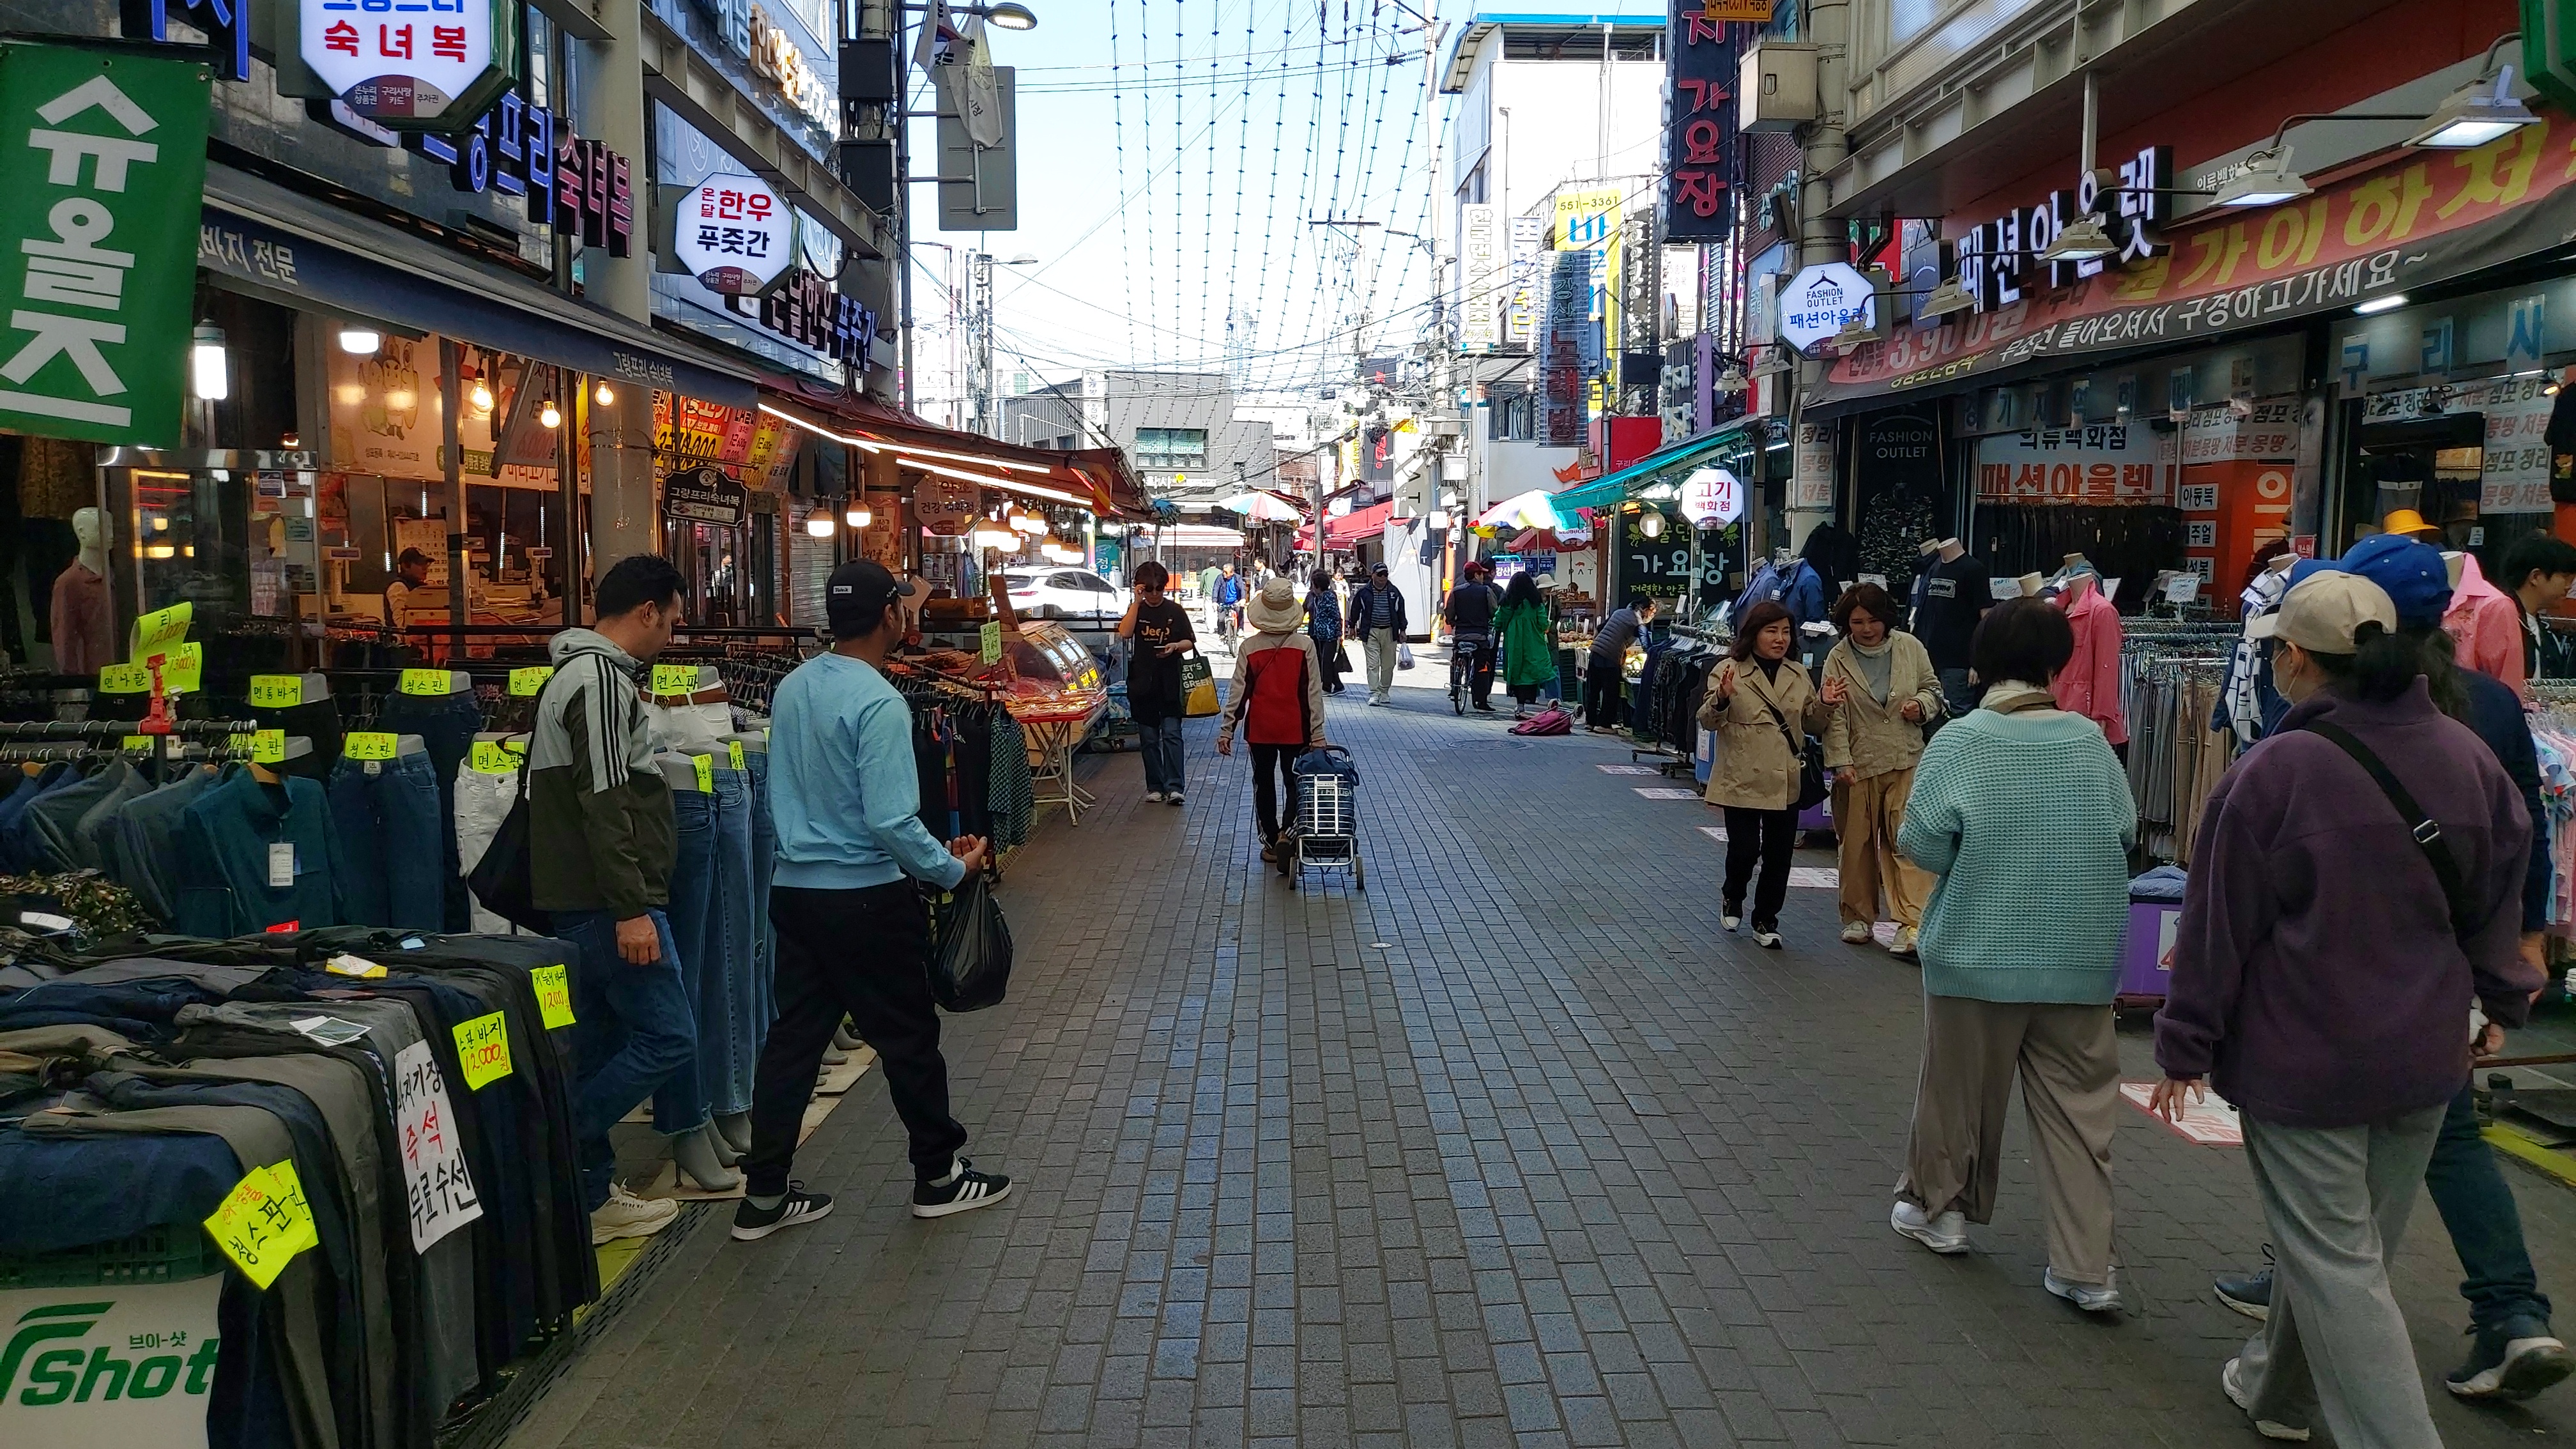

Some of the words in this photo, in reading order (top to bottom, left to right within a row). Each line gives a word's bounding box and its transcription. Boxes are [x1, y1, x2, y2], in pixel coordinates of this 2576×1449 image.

[325, 20, 467, 63] 숙녀복
[355, 86, 377, 95] 온누리
[355, 95, 378, 104] 상품권
[381, 86, 412, 96] 구리사랑
[417, 94, 439, 103] 주차권
[1678, 77, 1730, 217] 가요장
[556, 119, 632, 258] 숙녀복
[701, 188, 715, 218] 온달
[719, 189, 772, 222] 한우
[1560, 195, 1618, 211] 551-3361
[0, 73, 160, 428] 슈올즈
[696, 224, 770, 258] 푸줏간
[198, 224, 249, 273] 바지
[253, 236, 299, 286] 전문
[1552, 254, 1577, 323] 금강산
[1806, 288, 1843, 299] FASHION
[1807, 296, 1844, 308] OUTLET
[836, 293, 876, 372] 푸줏간
[2057, 305, 2174, 349] 들어오셔서
[613, 351, 651, 383] 그랑프리
[648, 361, 677, 389] 숙녀복
[1547, 329, 1581, 441] 노래방
[2489, 383, 2517, 405] 점포
[2252, 404, 2290, 424] 점포
[1800, 426, 1832, 445] 정리
[1869, 430, 1933, 443] FASHION
[1876, 447, 1928, 459] OUTLET
[2485, 451, 2516, 474] 점포
[2519, 448, 2550, 471] 정리
[1696, 482, 1731, 500] 고기
[1981, 463, 2154, 505] 패션아울렛
[670, 487, 740, 507] 그랑프리숙녀복
[1695, 500, 1731, 512] 백화점
[2182, 486, 2214, 508] 아동복
[921, 502, 940, 514] 건강
[2188, 523, 2212, 544] 주얼
[1631, 549, 1729, 585] 가요장
[1630, 583, 1663, 596] 저렴한
[1182, 673, 1194, 681] GO
[1183, 680, 1213, 689] GREEN
[477, 1016, 502, 1041] 바지
[406, 1100, 445, 1171] 즉석
[228, 1194, 293, 1266] 청스판
[129, 1331, 187, 1351] 브이-샷
